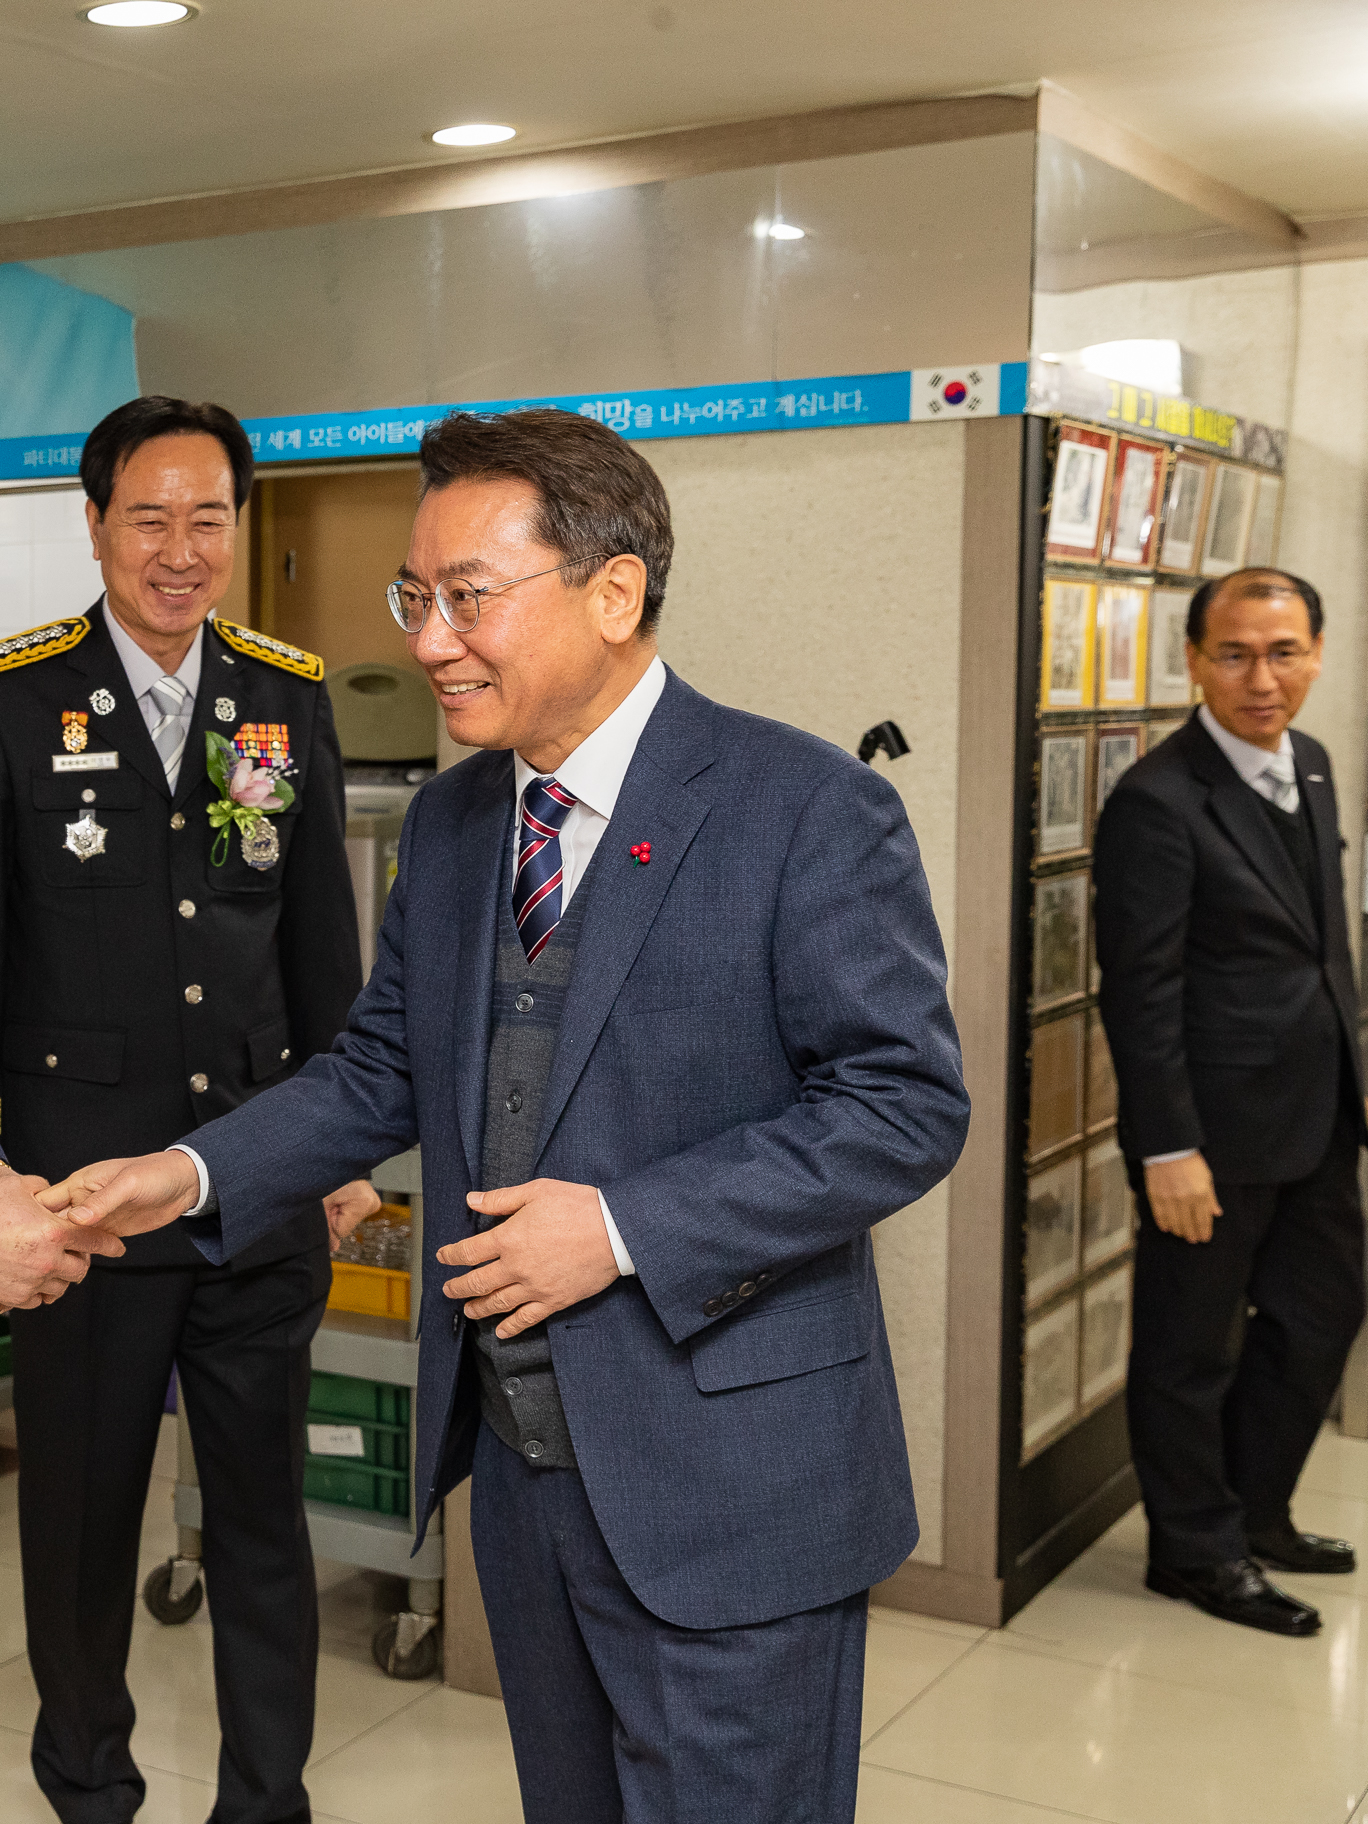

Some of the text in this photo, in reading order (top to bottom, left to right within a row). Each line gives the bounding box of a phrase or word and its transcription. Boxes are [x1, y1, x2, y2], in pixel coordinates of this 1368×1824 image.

[267, 429, 302, 450] 세계
[308, 425, 343, 447] 모든
[578, 399, 653, 432] 희망을
[660, 398, 767, 425] 나누어주고
[774, 389, 870, 418] 계십니다.
